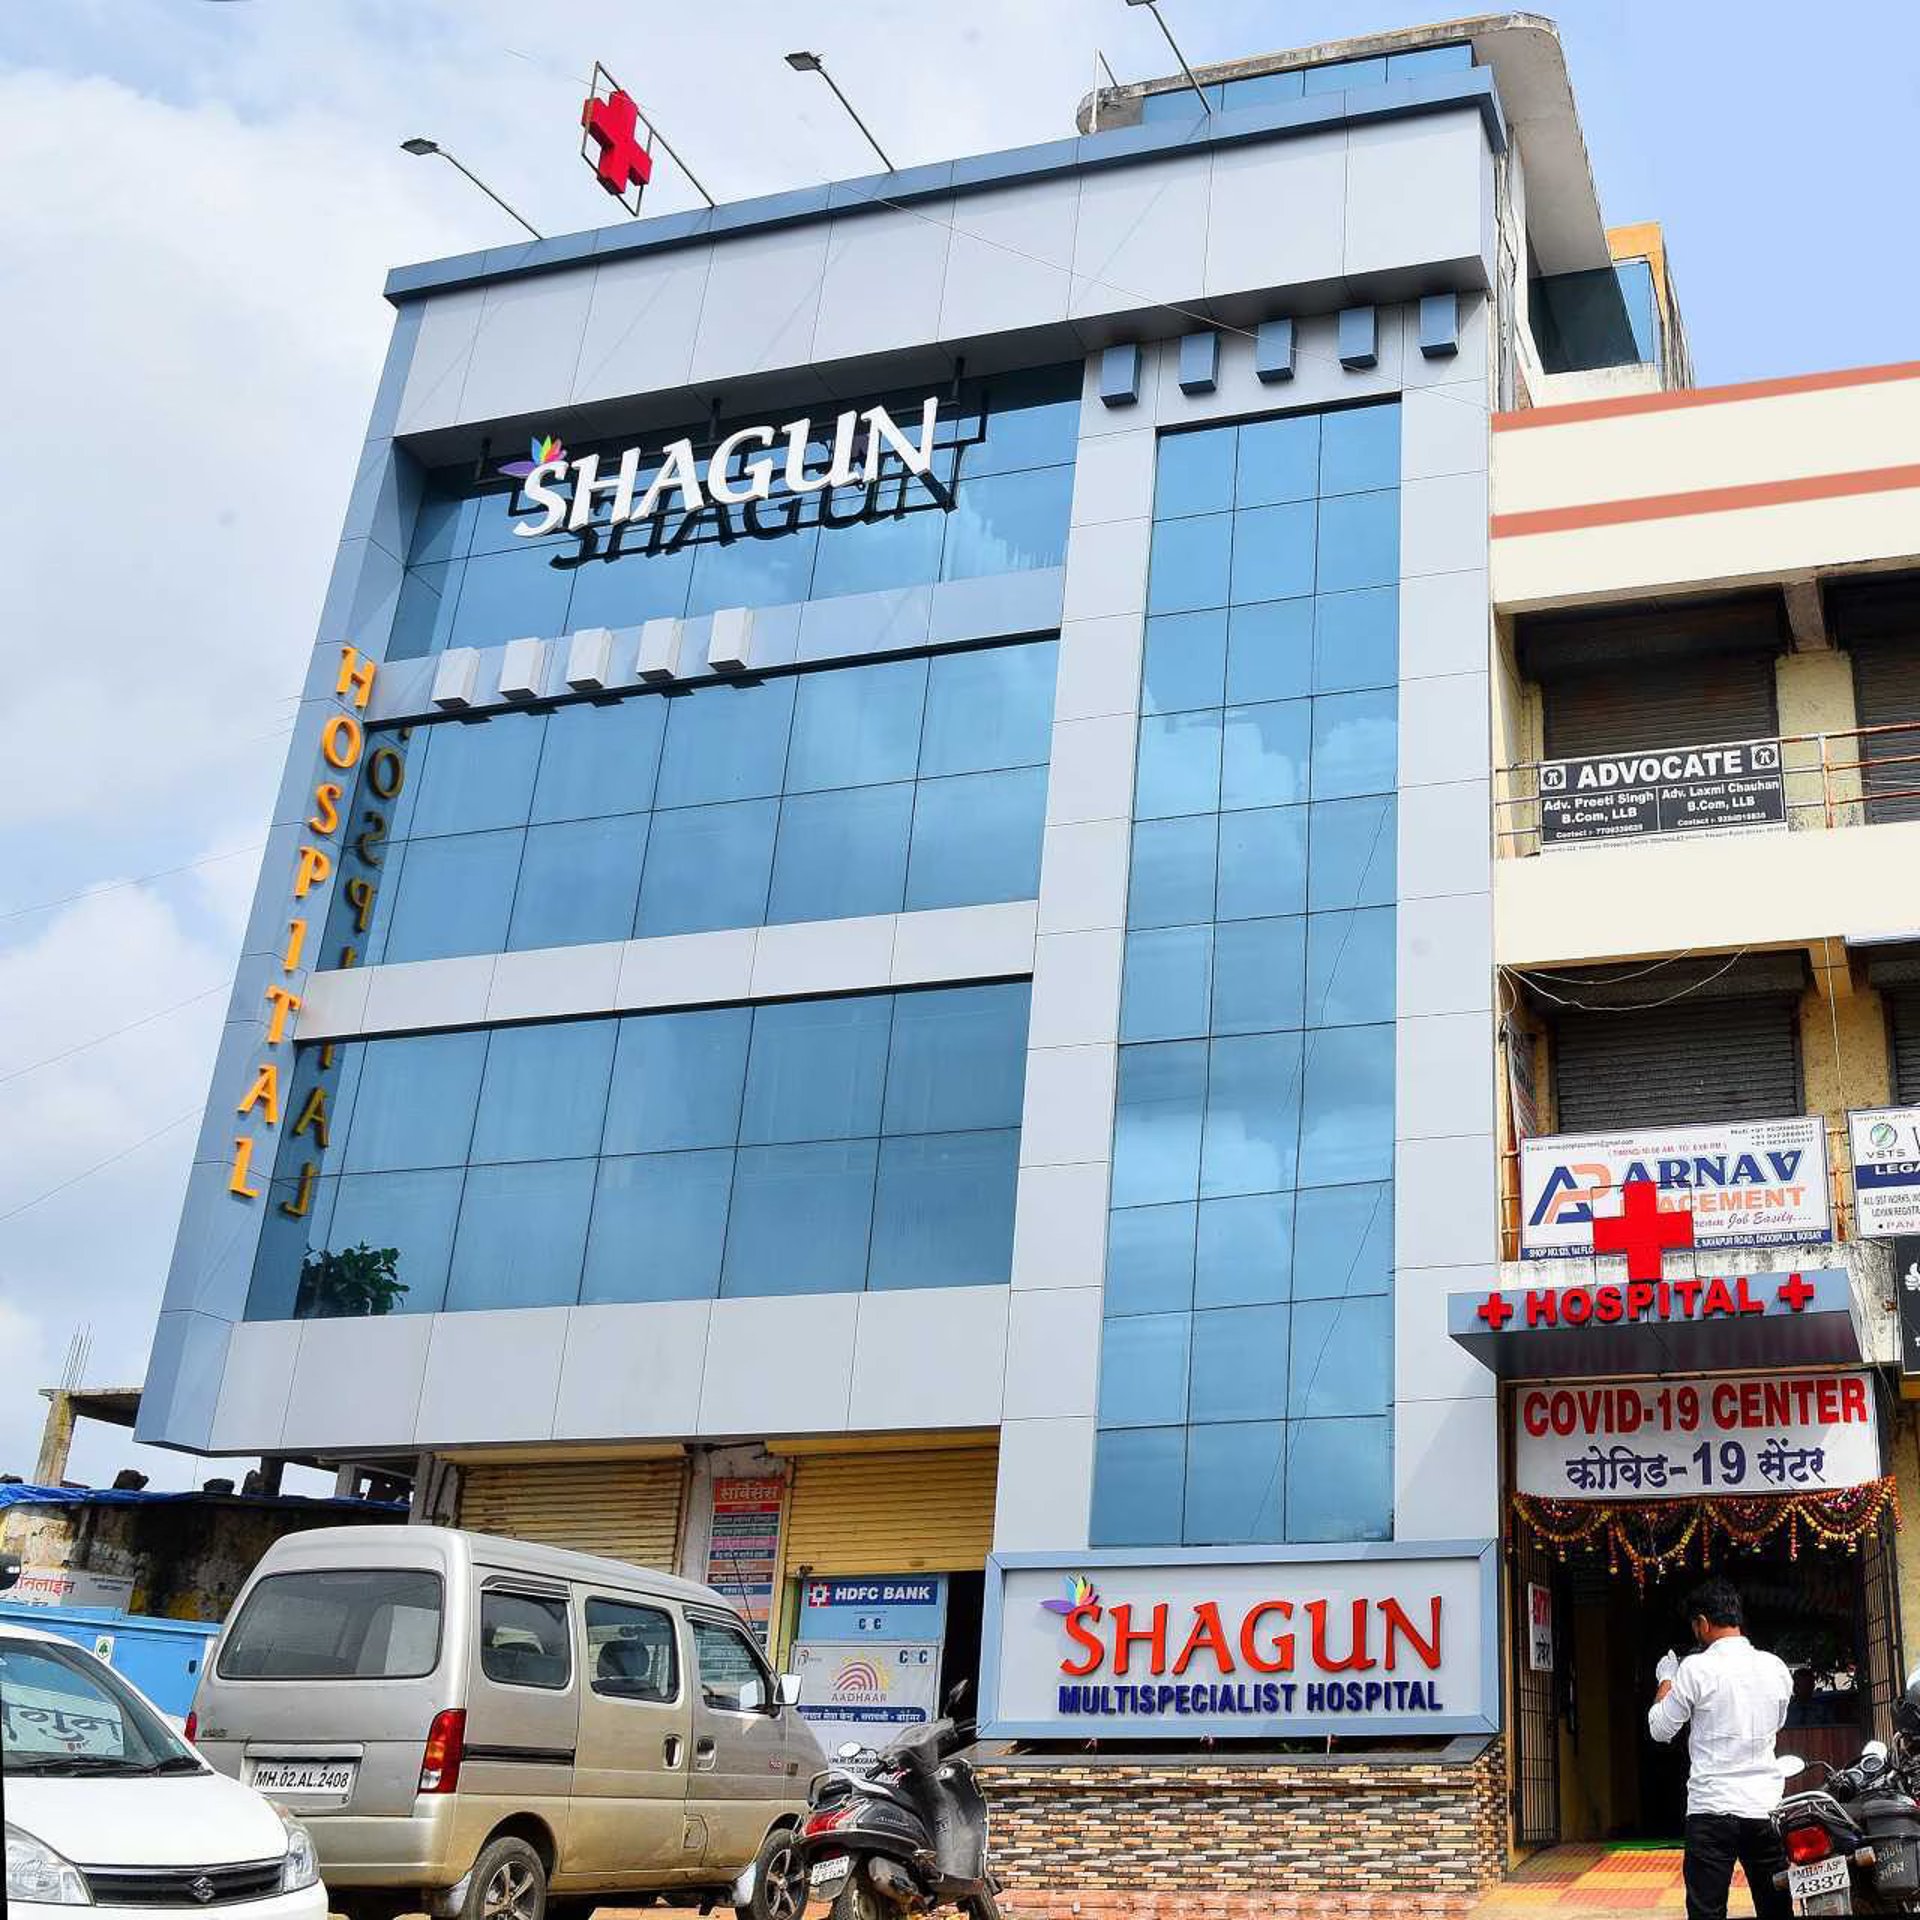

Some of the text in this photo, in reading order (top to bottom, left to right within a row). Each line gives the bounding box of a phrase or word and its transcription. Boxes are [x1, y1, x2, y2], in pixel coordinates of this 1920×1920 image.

[513, 396, 938, 538] SHAGUN
[1577, 750, 1743, 789] ADVOCATE
[1544, 791, 1654, 811] Adv. Preeti Singh
[1662, 780, 1780, 800] Adv. Laxmi Chauhan
[1732, 796, 1755, 807] LLB
[1612, 807, 1637, 819] LLB
[228, 646, 375, 1199] HOSPITAL
[1866, 1148, 1906, 1158] VSTS
[1620, 1151, 1802, 1192] ARNAV
[1619, 1187, 1806, 1214] ACEMENT
[1728, 1212, 1749, 1228] Job
[1525, 1277, 1765, 1327] HOSPITAL
[1523, 1377, 1868, 1437] COVID-19 CENTER
[1566, 1438, 1826, 1490] कोविड-19 सेंटर
[835, 1586, 930, 1600] HDFC BANK
[1060, 1595, 1443, 1675] SHAGUN
[831, 1692, 887, 1702] AADHAAR
[1058, 1680, 1443, 1715] MULTISPECIALIST HOSPITAL
[1795, 1871, 1846, 1894] 4337
